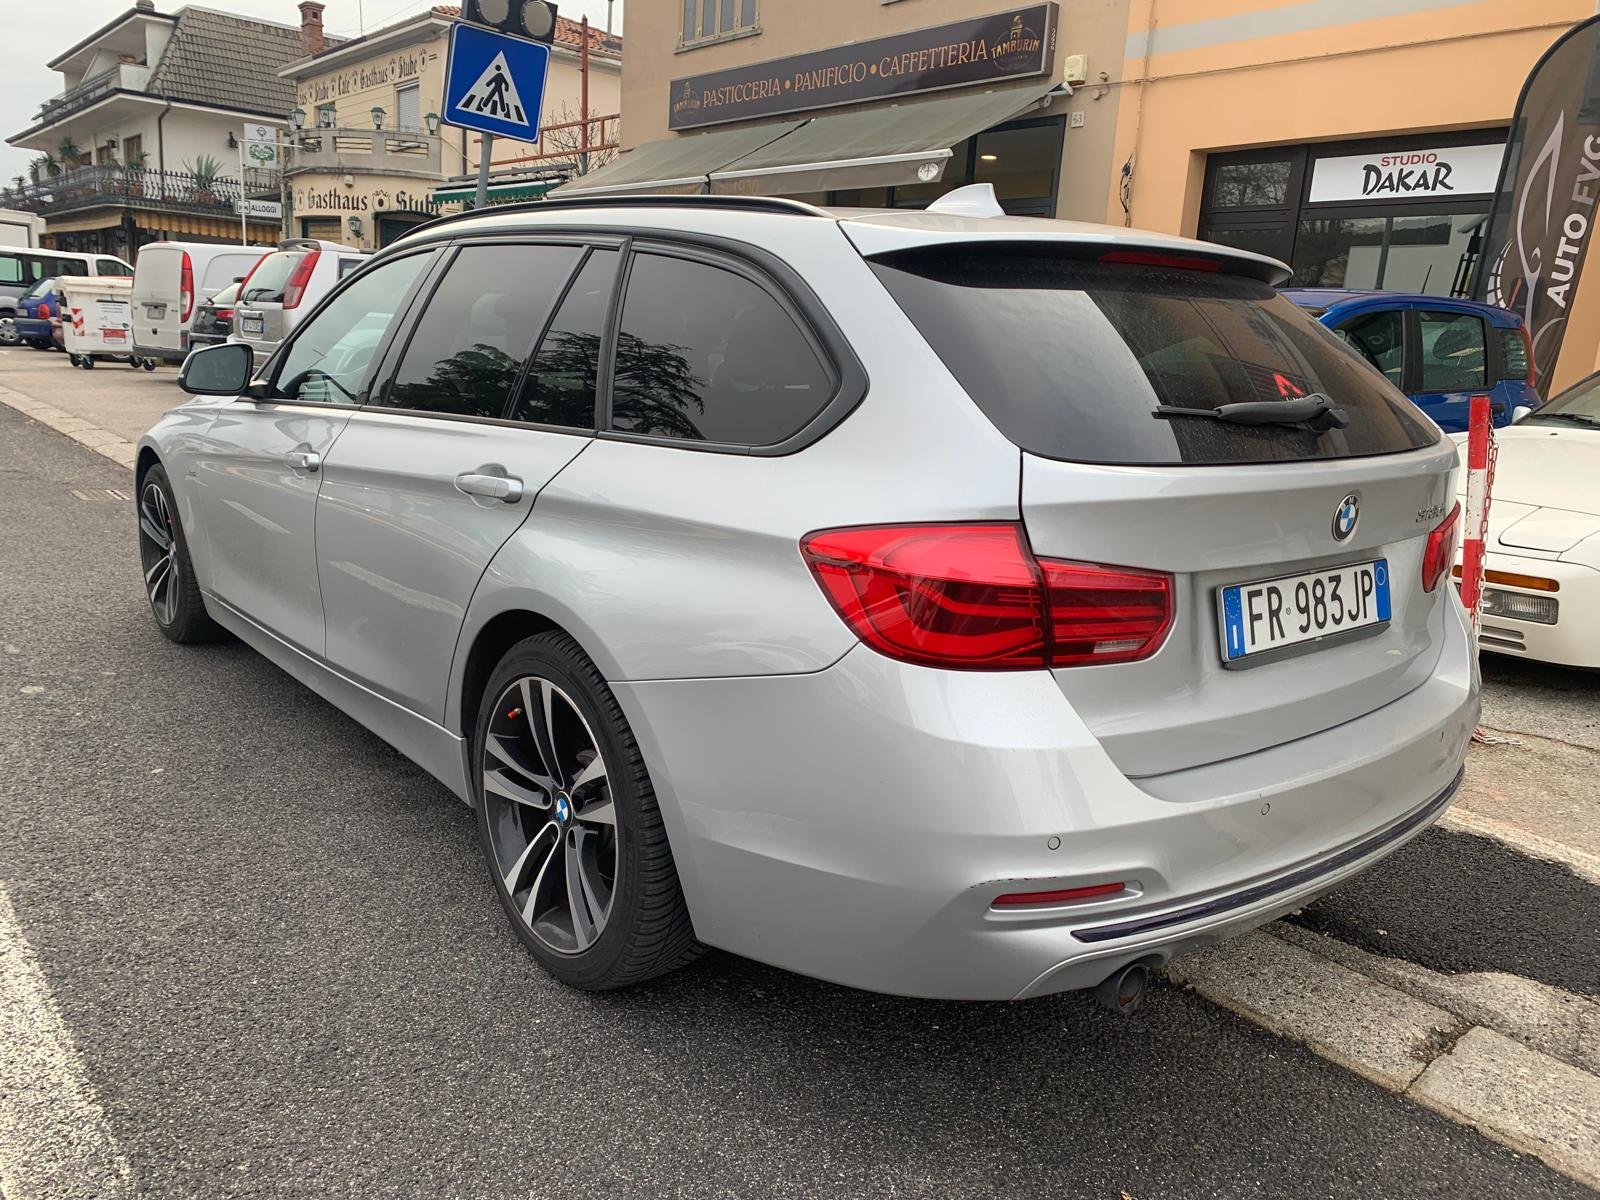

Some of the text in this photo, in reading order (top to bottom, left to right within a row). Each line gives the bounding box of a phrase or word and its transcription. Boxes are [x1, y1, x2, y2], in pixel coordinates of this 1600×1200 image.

[990, 38, 1041, 59] TAMBURIN
[360, 65, 389, 90] Gasthaus
[398, 54, 418, 79] Stube
[703, 38, 989, 109] PASTICCERIA PANIFICIO CAFFETTERIA
[1380, 153, 1438, 168] STUDIO
[1361, 161, 1455, 196] DAKAR
[251, 204, 277, 214] ALLOGGI
[307, 186, 368, 212] Gasthaus
[1546, 133, 1600, 309] AUTO FVG
[1247, 585, 1286, 646] FR
[1295, 574, 1344, 635] 983
[1347, 569, 1374, 622] JP
